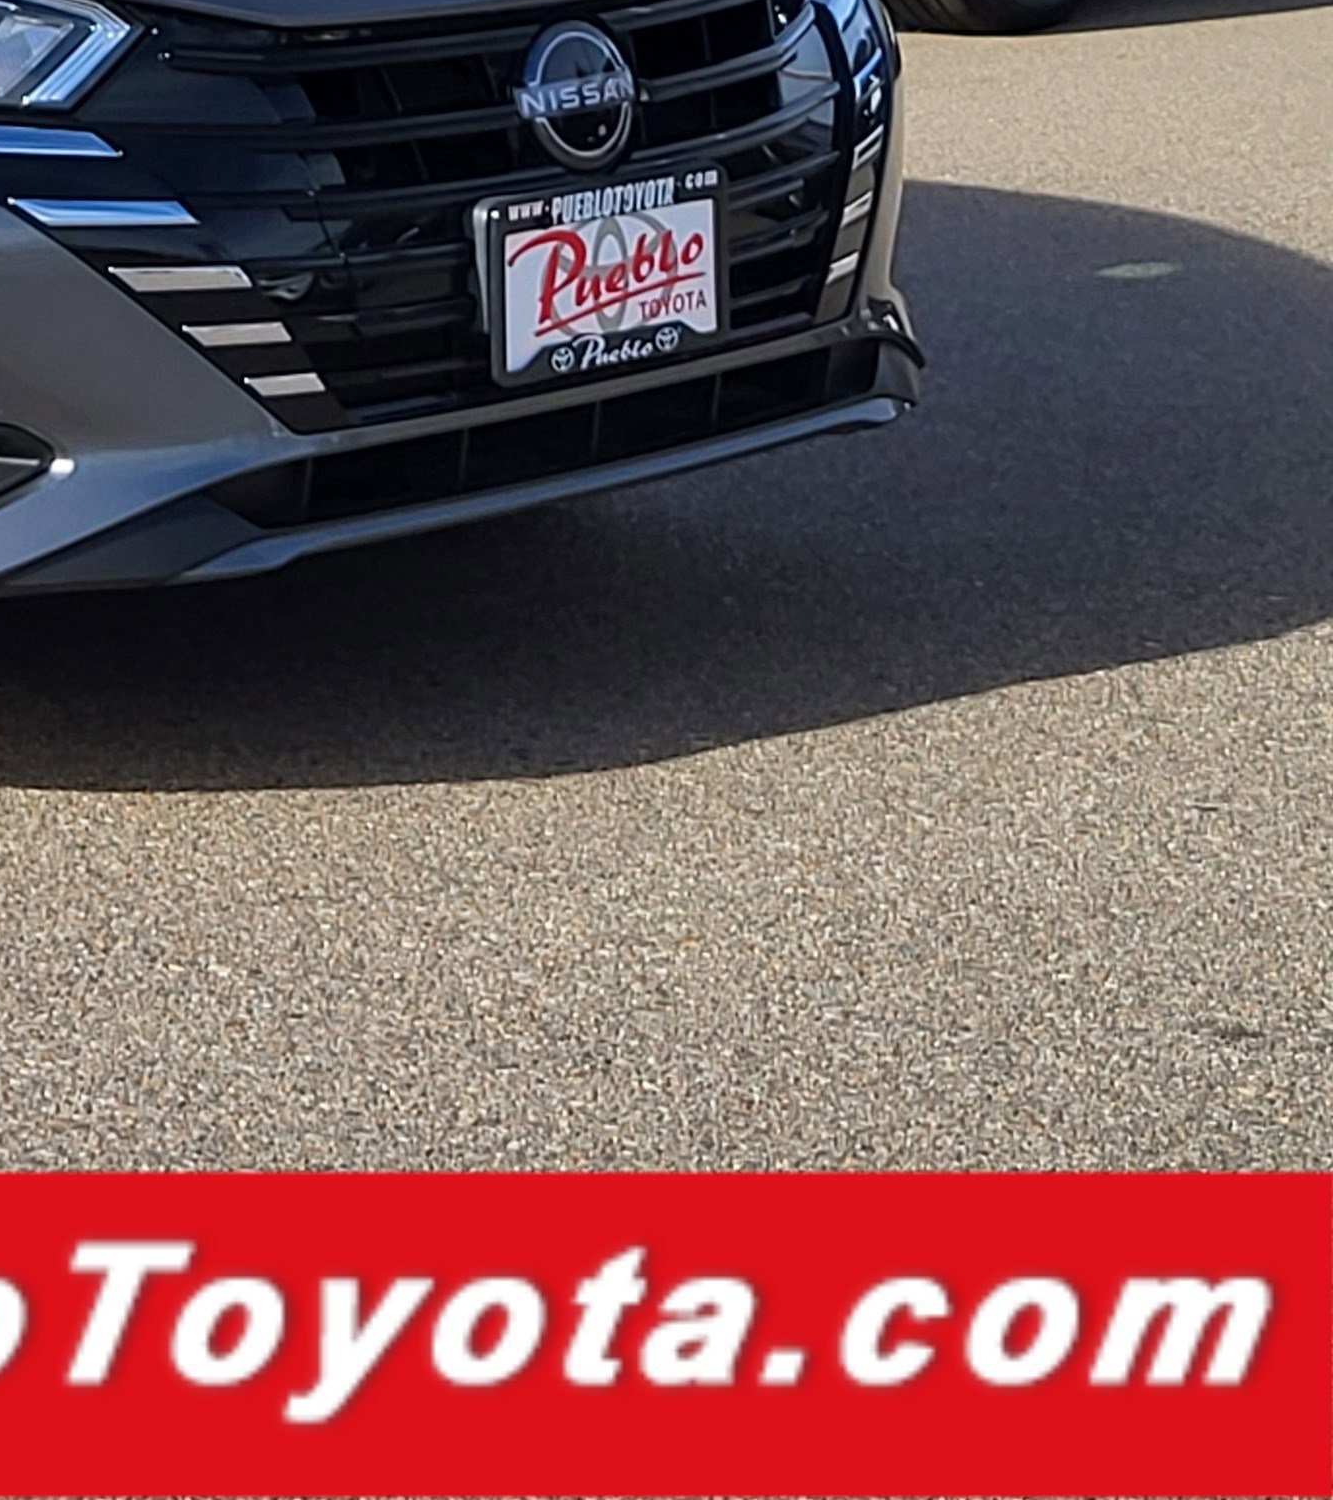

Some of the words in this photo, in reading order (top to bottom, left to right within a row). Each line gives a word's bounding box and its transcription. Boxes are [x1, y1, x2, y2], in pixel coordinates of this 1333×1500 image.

[518, 75, 636, 116] NISSAN
[507, 228, 705, 325] Pueblo
[638, 290, 708, 321] TOYOTA
[571, 334, 654, 370] Pueblo
